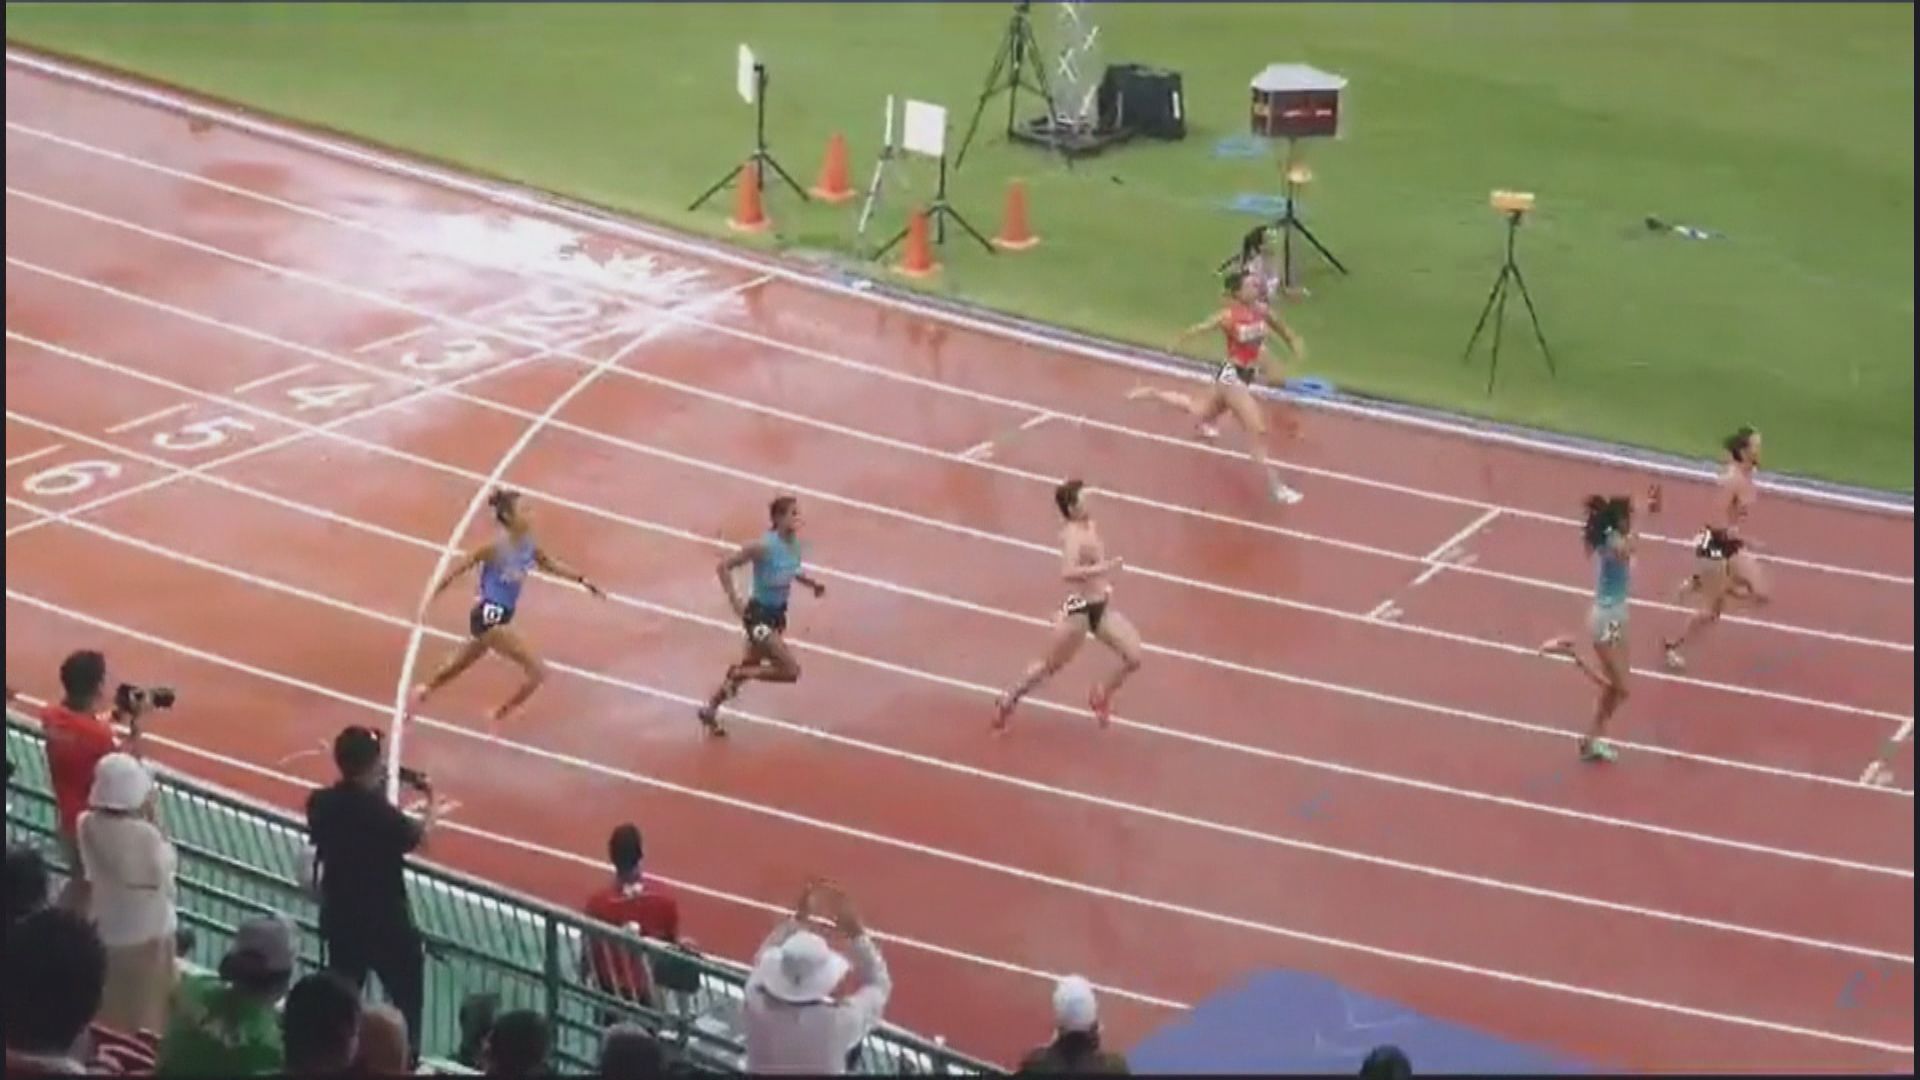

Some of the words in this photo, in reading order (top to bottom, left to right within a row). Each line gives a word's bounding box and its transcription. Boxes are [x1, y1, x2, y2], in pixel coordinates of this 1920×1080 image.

[400, 338, 494, 370] 3
[287, 383, 376, 411] 4
[152, 416, 255, 450] 5
[22, 460, 121, 495] 6
